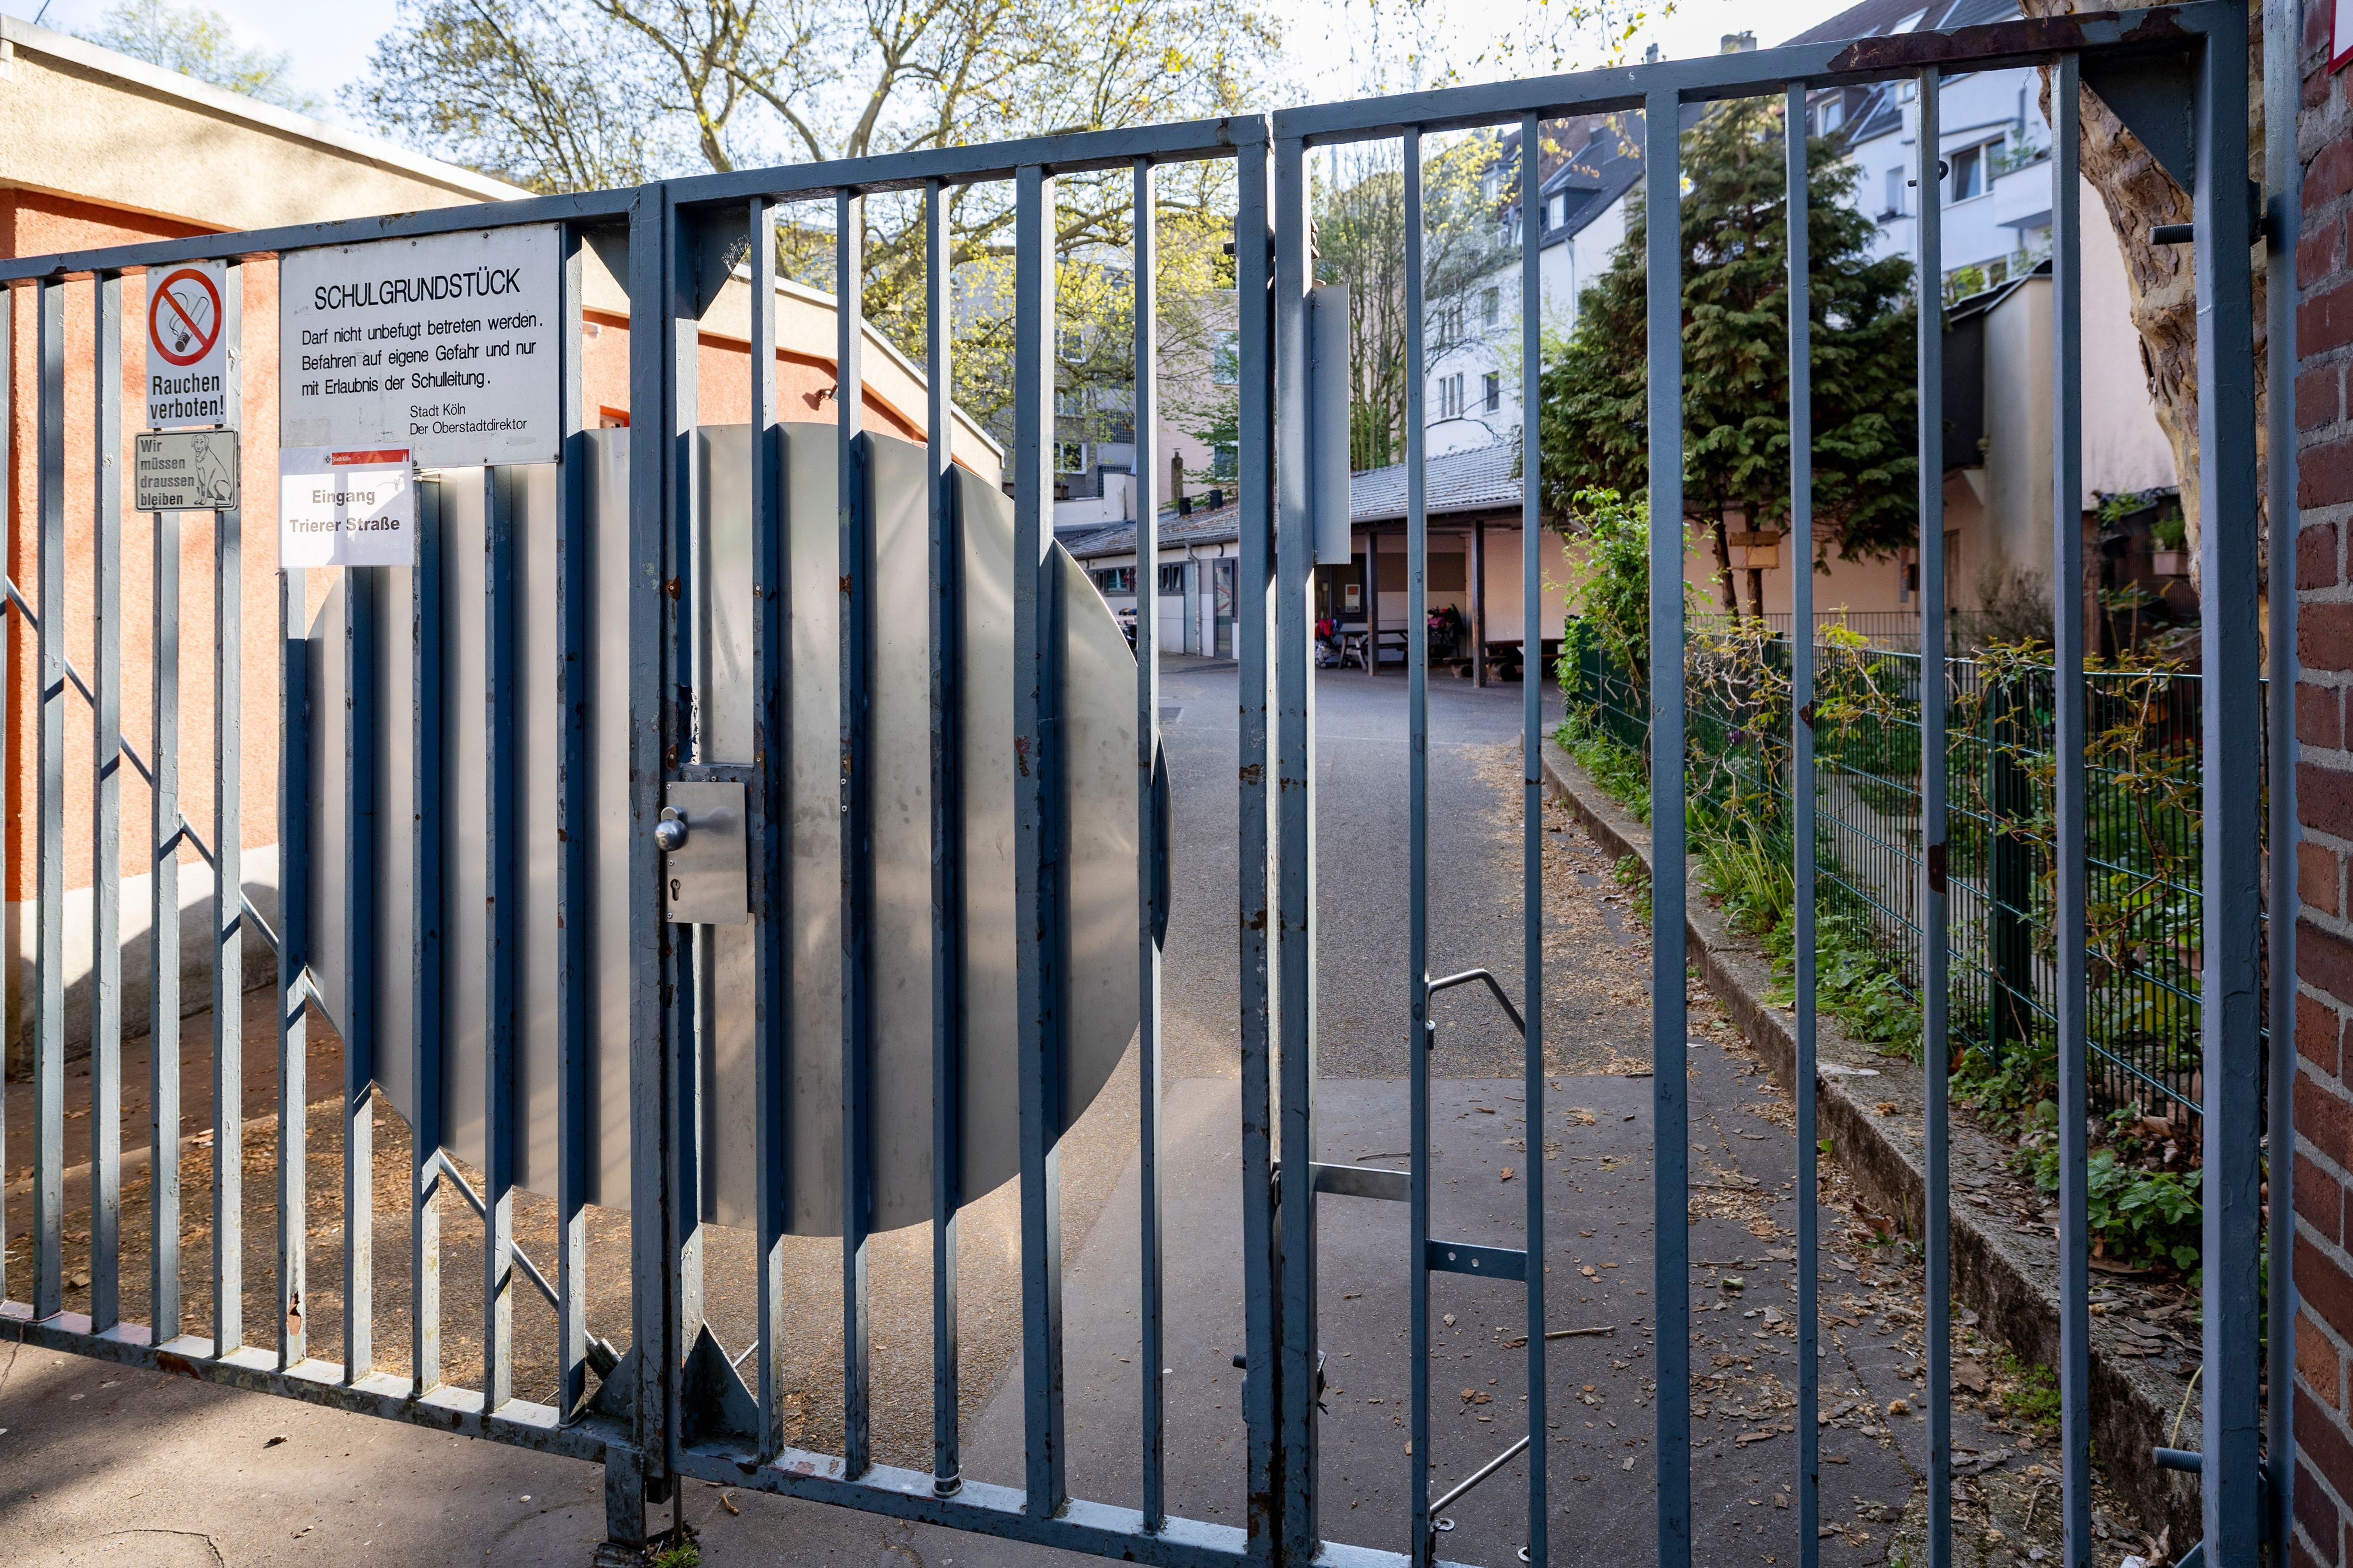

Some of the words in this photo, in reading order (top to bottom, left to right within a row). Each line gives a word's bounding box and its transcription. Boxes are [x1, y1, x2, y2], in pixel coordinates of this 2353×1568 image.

[314, 266, 521, 310] SCHULGRUNDSTÜCK
[302, 328, 328, 345] Darf
[334, 325, 362, 342] nicht
[368, 322, 421, 340] unbefugt
[428, 318, 481, 335] betreten
[488, 312, 542, 330] werden.
[302, 352, 356, 371] Befahren
[362, 351, 382, 366] auf
[388, 349, 429, 367] eigene
[436, 345, 479, 361] Gefahr
[486, 341, 509, 357] und
[516, 341, 536, 354] nur
[152, 373, 220, 395] Rauchen
[302, 382, 319, 396] mit
[325, 376, 378, 395] Erlaubnis
[385, 376, 405, 391] der
[412, 371, 491, 389] Schulleitung.
[150, 395, 224, 419] verboten!
[410, 405, 439, 418] Stadt
[444, 403, 465, 415] Köln
[410, 422, 429, 435] Der
[433, 419, 527, 433] Oberstadtdirektor
[141, 440, 162, 452] Wir
[141, 457, 185, 470] müssen
[141, 475, 195, 488] draussen
[141, 492, 184, 506] bleiben
[312, 490, 375, 506] Eingang
[290, 519, 341, 532] Trierer
[346, 517, 400, 531] Straße
